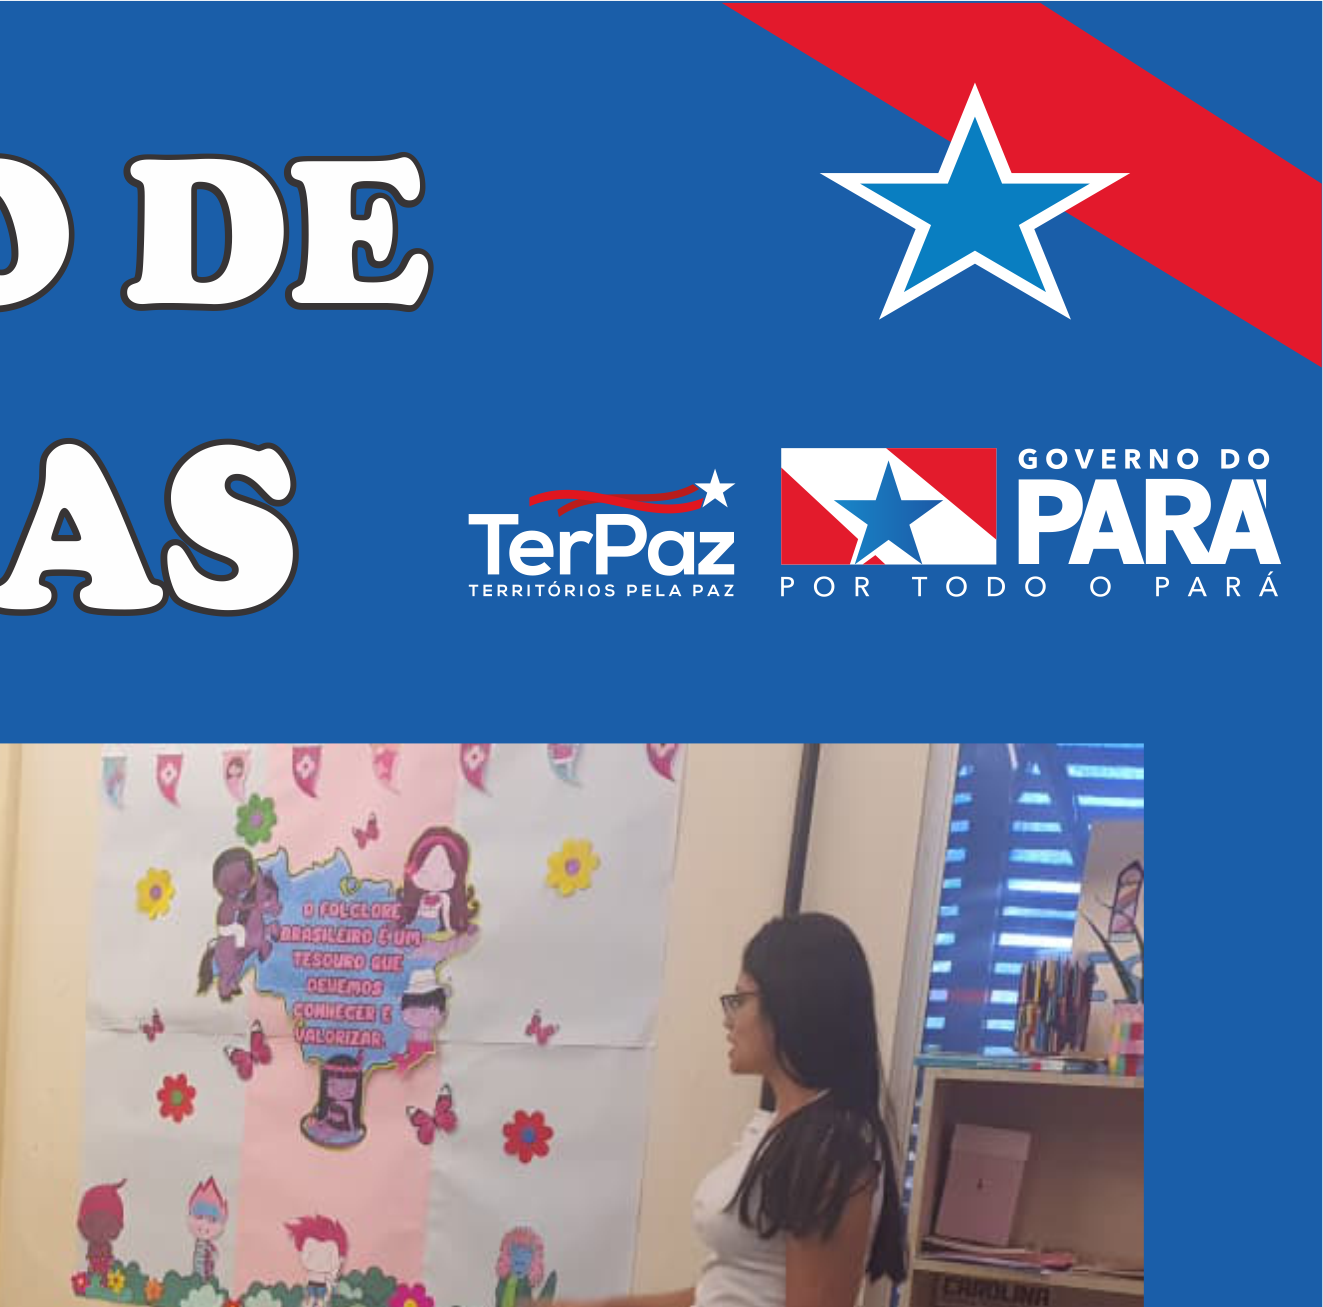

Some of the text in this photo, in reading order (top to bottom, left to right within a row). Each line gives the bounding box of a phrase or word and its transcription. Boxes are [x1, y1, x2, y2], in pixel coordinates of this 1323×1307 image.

[318, 901, 403, 921] FOLCLORE
[279, 924, 373, 945] BRASILEIRO
[393, 929, 423, 946] UM
[292, 950, 404, 973] TESOURO QUE
[306, 977, 384, 997] DEVEMOS
[293, 1002, 392, 1024] CONHECER E
